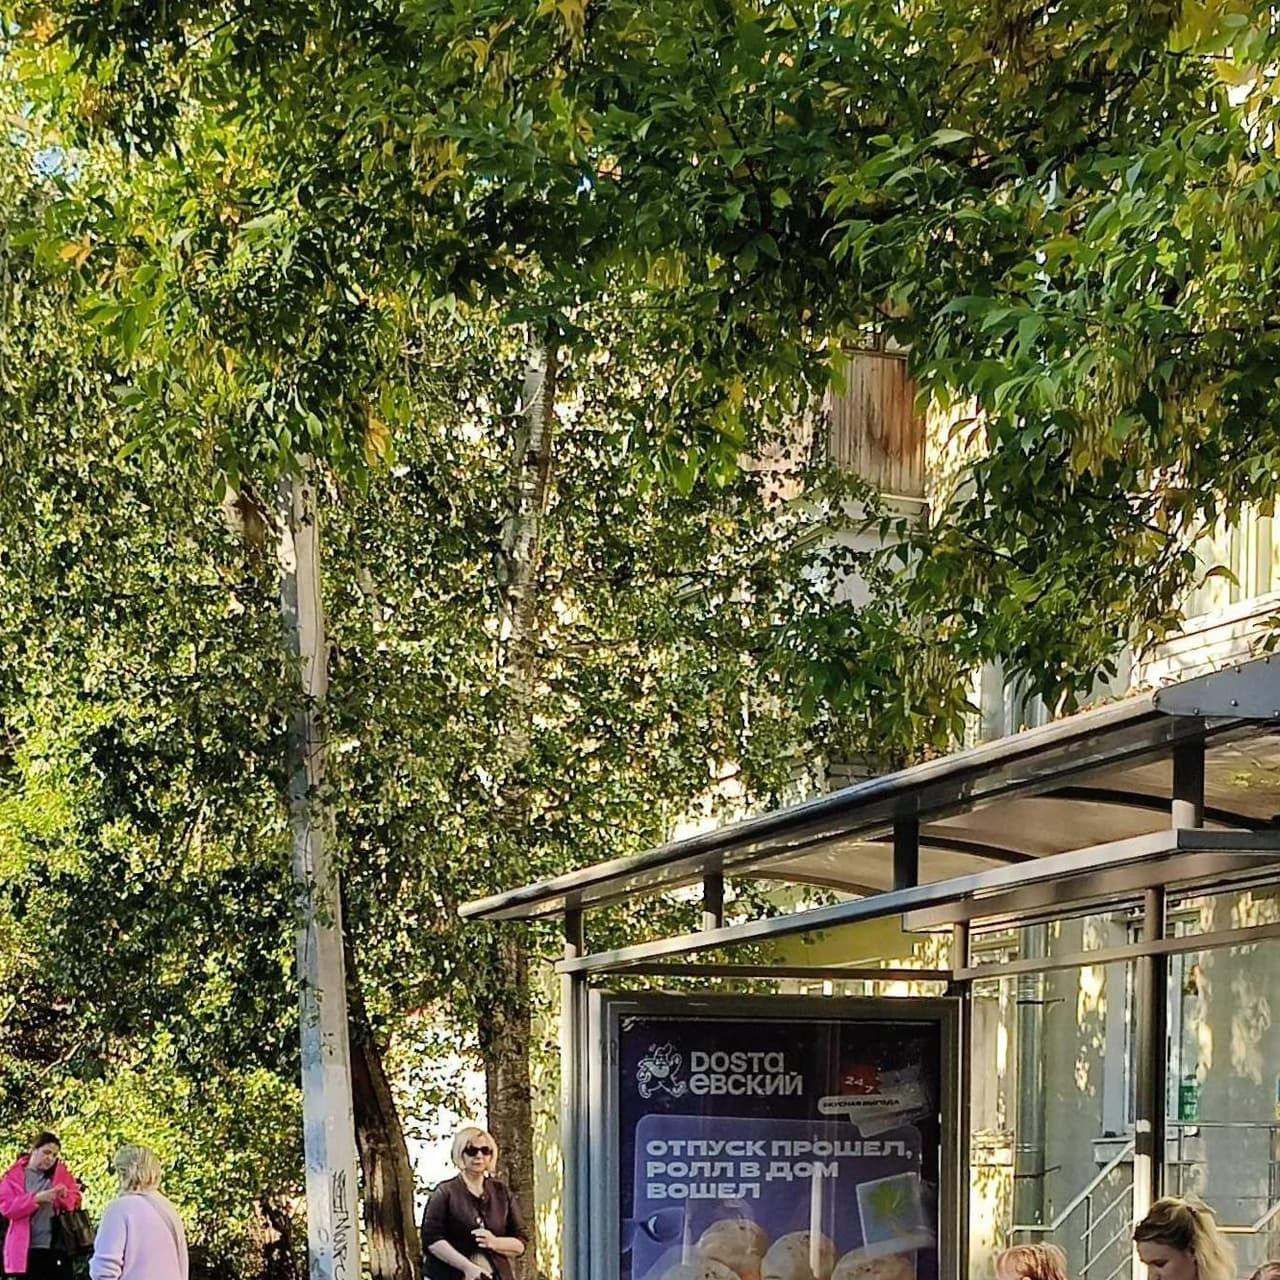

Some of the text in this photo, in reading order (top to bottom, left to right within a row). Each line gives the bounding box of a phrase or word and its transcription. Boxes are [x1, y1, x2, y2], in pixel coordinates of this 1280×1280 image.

[646, 1140, 913, 1160] ОТПУСК ПРОШЕЛ,
[646, 1161, 839, 1181] РОЛЛ В ДОМ
[646, 1182, 761, 1200] ВОШЕЛ
